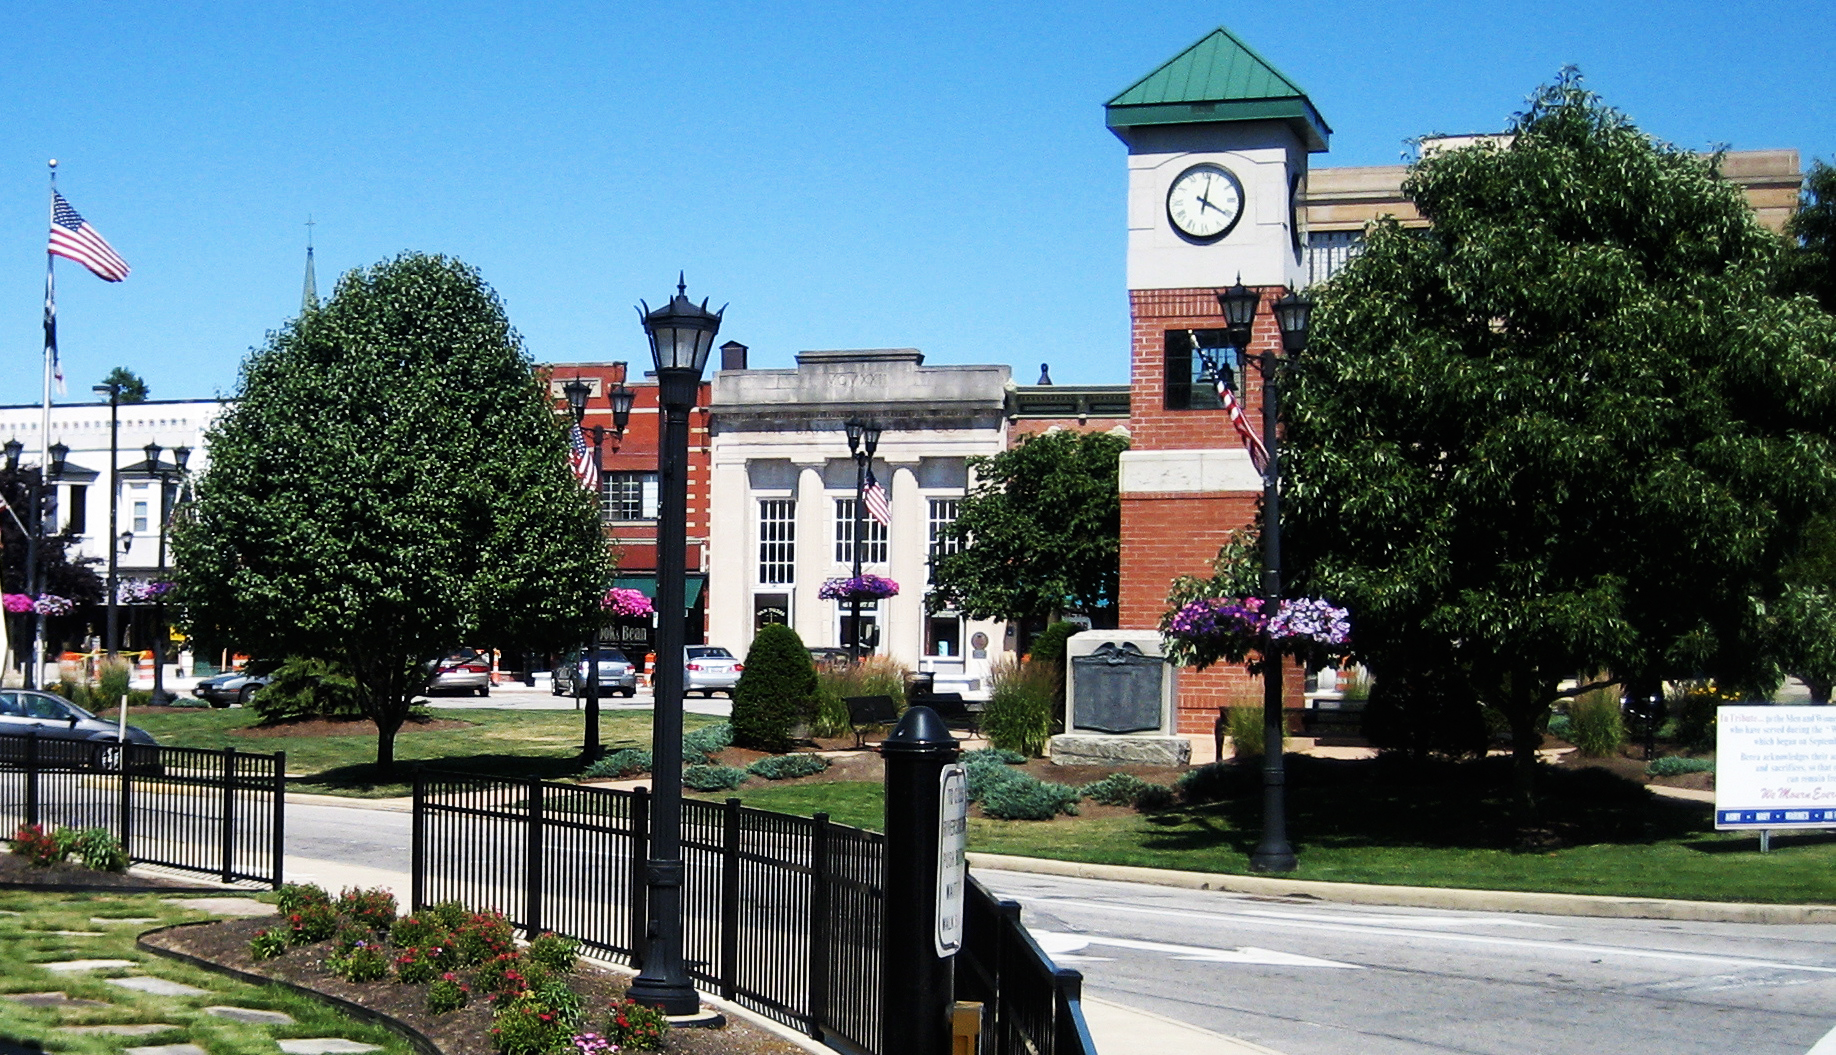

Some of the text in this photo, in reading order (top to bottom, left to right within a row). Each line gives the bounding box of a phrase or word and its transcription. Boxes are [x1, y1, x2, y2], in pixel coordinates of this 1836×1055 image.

[622, 625, 647, 640] Bean
[1754, 737, 1774, 745] which
[1756, 764, 1768, 772] and
[1777, 787, 1811, 799] Mourn
